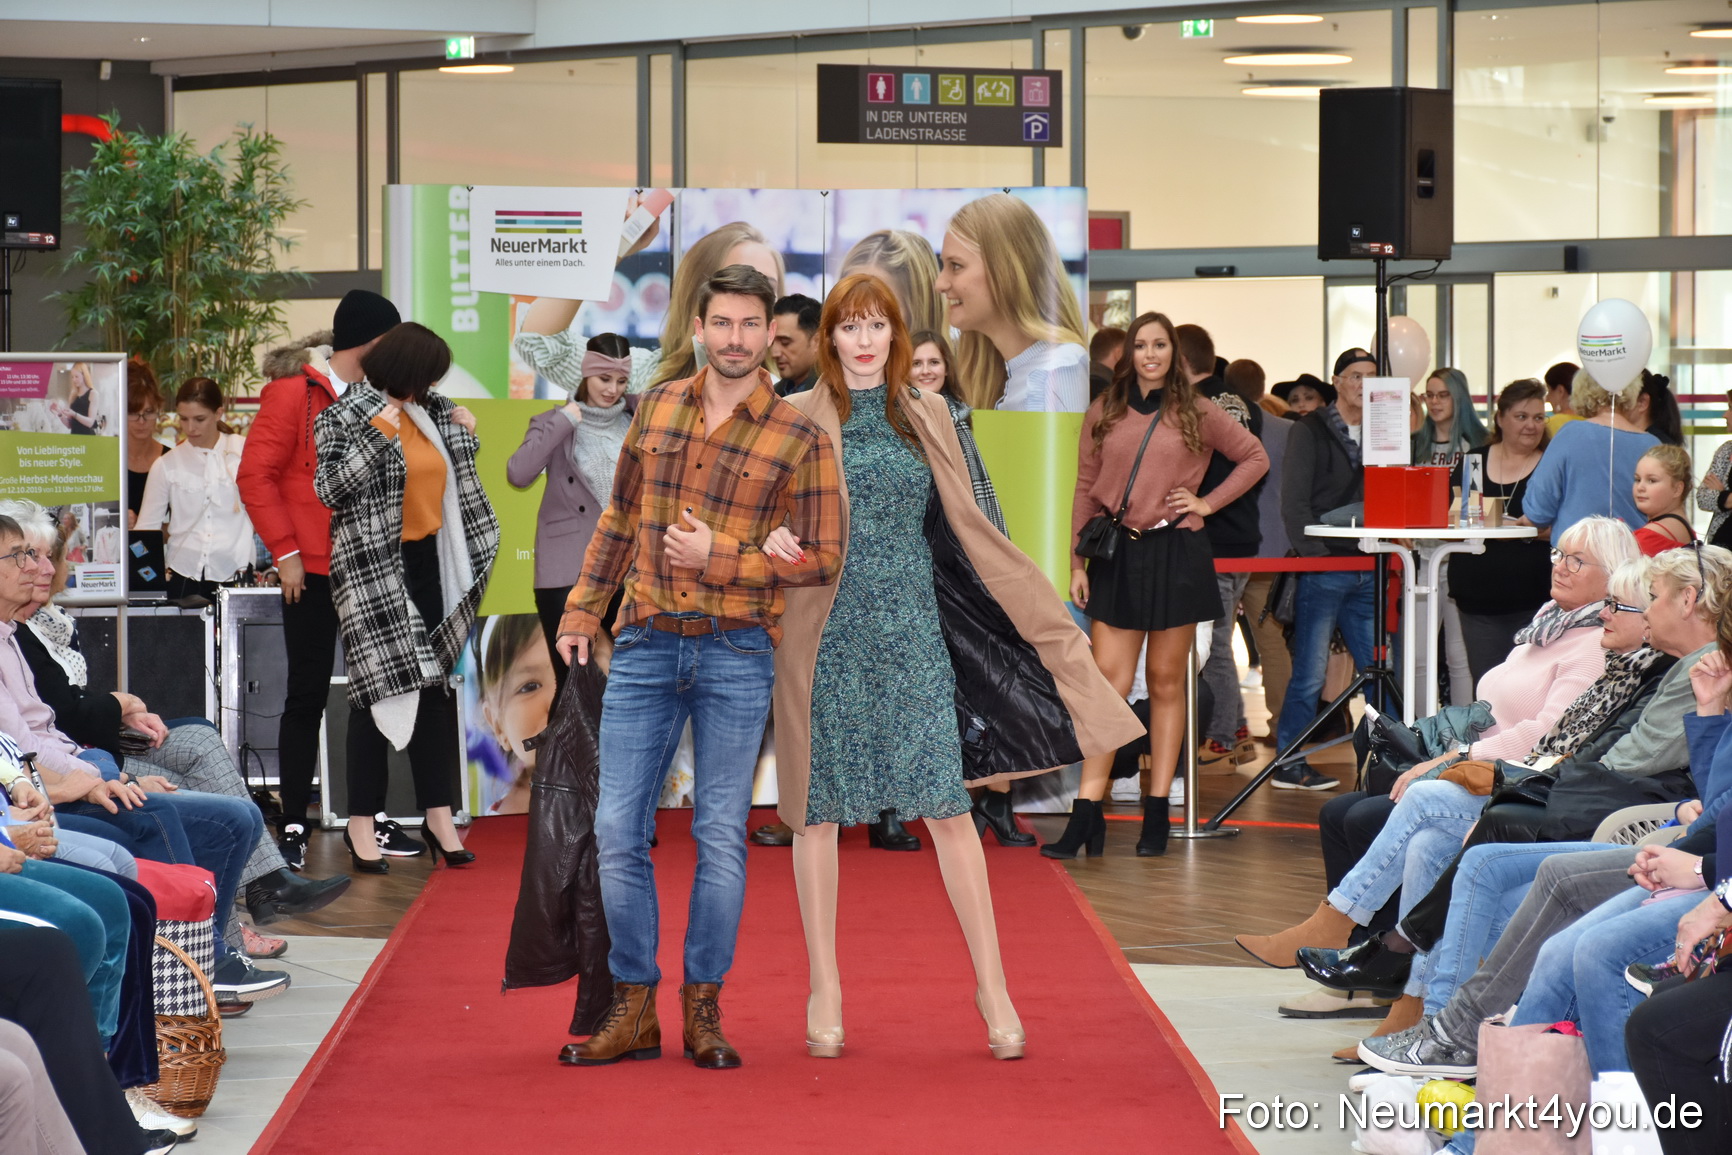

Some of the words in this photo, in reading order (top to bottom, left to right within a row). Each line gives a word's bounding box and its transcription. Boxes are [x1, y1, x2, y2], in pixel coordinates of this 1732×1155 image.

[866, 110, 878, 123] IN
[882, 110, 903, 123] DER
[909, 111, 967, 124] UNTEREN
[866, 128, 967, 141] LADENSTRASSE
[1031, 121, 1043, 140] P
[44, 235, 54, 244] 12
[490, 237, 588, 254] NeuerMarkt
[1384, 245, 1393, 254] 12
[495, 258, 513, 267] Alles
[514, 259, 535, 267] unter
[536, 259, 561, 267] einem
[562, 258, 585, 267] Dach.
[16, 446, 33, 455] Von
[34, 445, 86, 457] Lieblingsteil
[19, 458, 32, 467] bis
[33, 459, 58, 467] neuer
[59, 458, 83, 469] Style.
[19, 474, 104, 484] Herbst-Modenschau
[7, 486, 42, 494] 12.10.2019
[81, 580, 117, 588] NeuerMarkt
